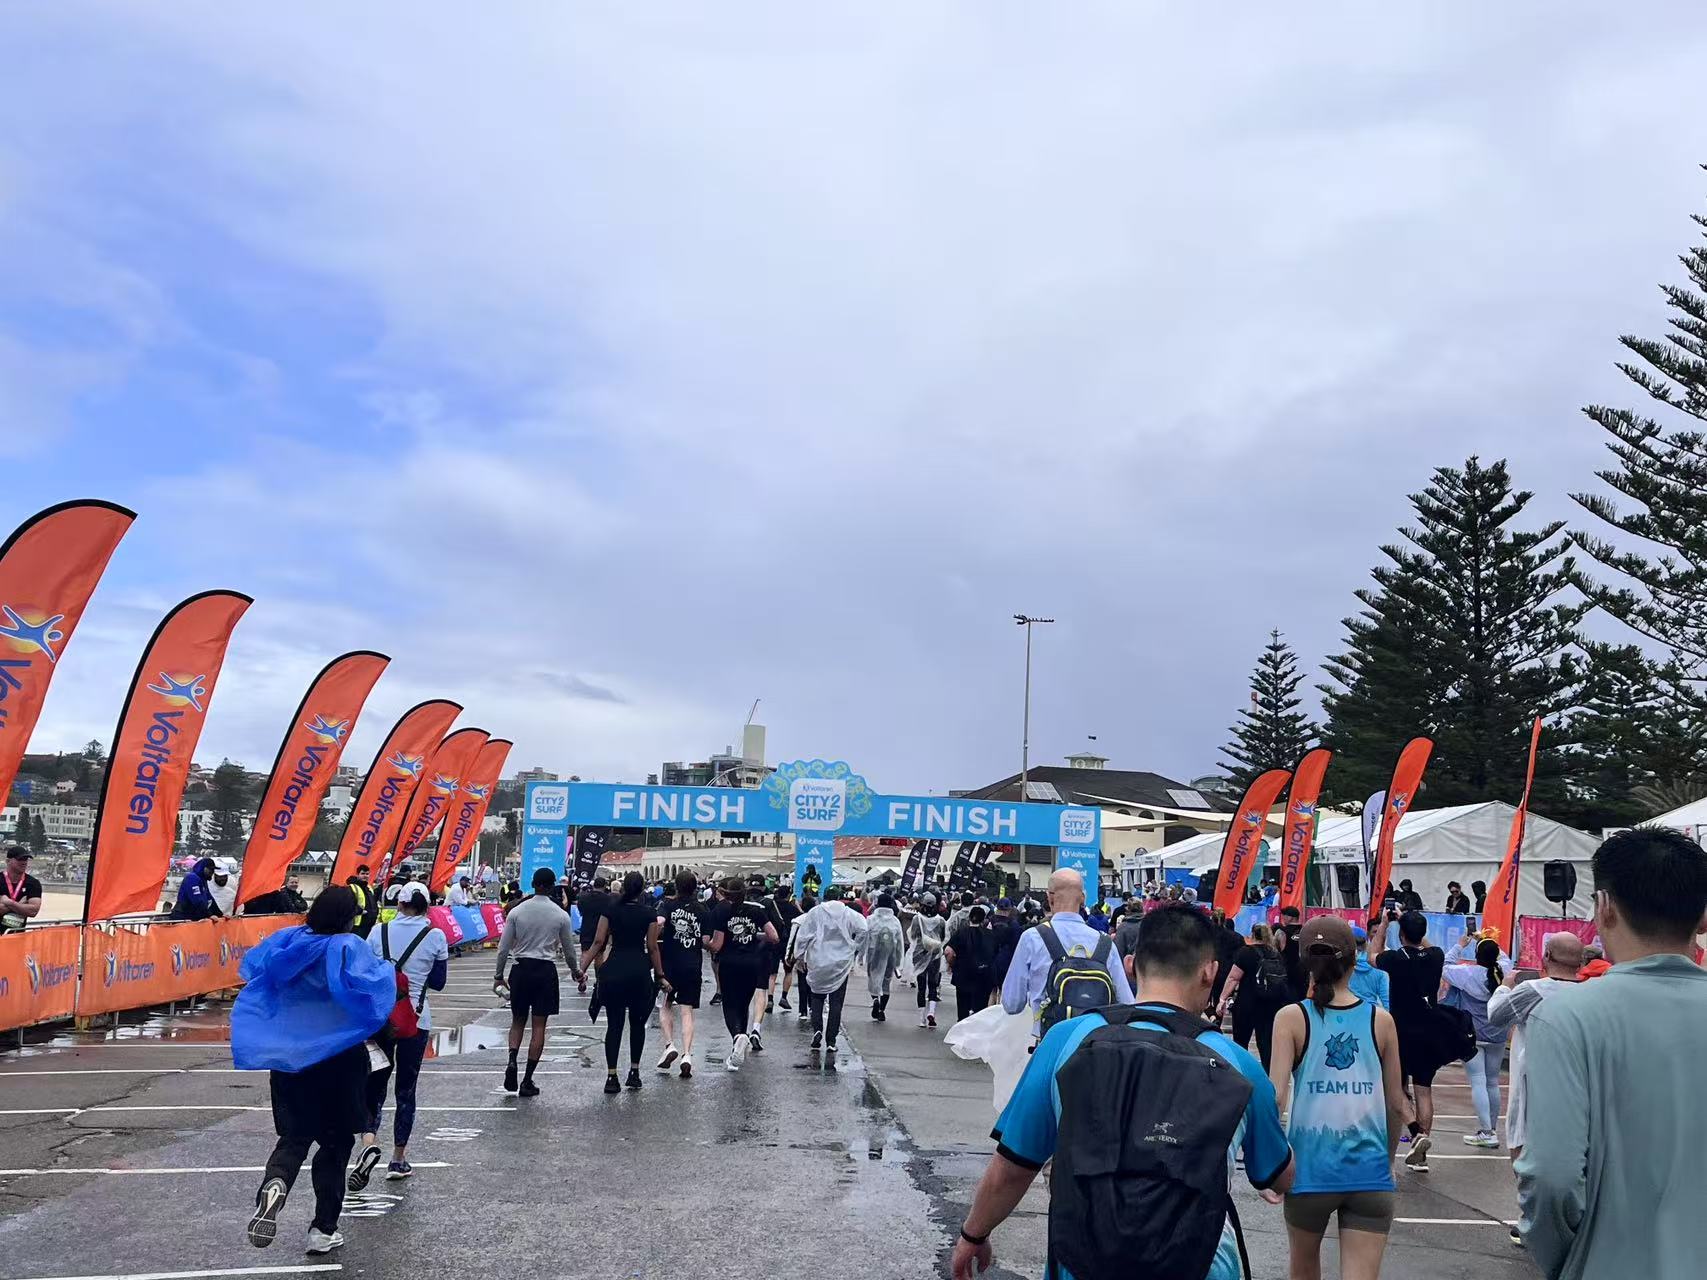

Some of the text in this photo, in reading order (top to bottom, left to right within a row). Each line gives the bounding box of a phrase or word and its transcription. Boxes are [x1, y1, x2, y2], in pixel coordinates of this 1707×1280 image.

[125, 711, 184, 835] Voltaren
[268, 744, 329, 841] Voltaren
[612, 790, 745, 825] FINISH
[355, 775, 406, 857] Voltaren
[535, 805, 563, 814] SURF
[796, 808, 839, 821] SURF
[888, 801, 1017, 837] FINISH
[445, 801, 479, 863] Voltaren
[536, 827, 563, 836] Voltaren
[806, 836, 834, 846] Voltaren
[1064, 828, 1091, 838] SURF
[533, 846, 554, 855] rebel
[1069, 850, 1097, 860] Voltaren
[1225, 828, 1256, 892] Voltaren
[1283, 820, 1310, 895] Voltaren
[671, 908, 702, 938] RUNNING
[1307, 1080, 1374, 1096] TEAM UTS
